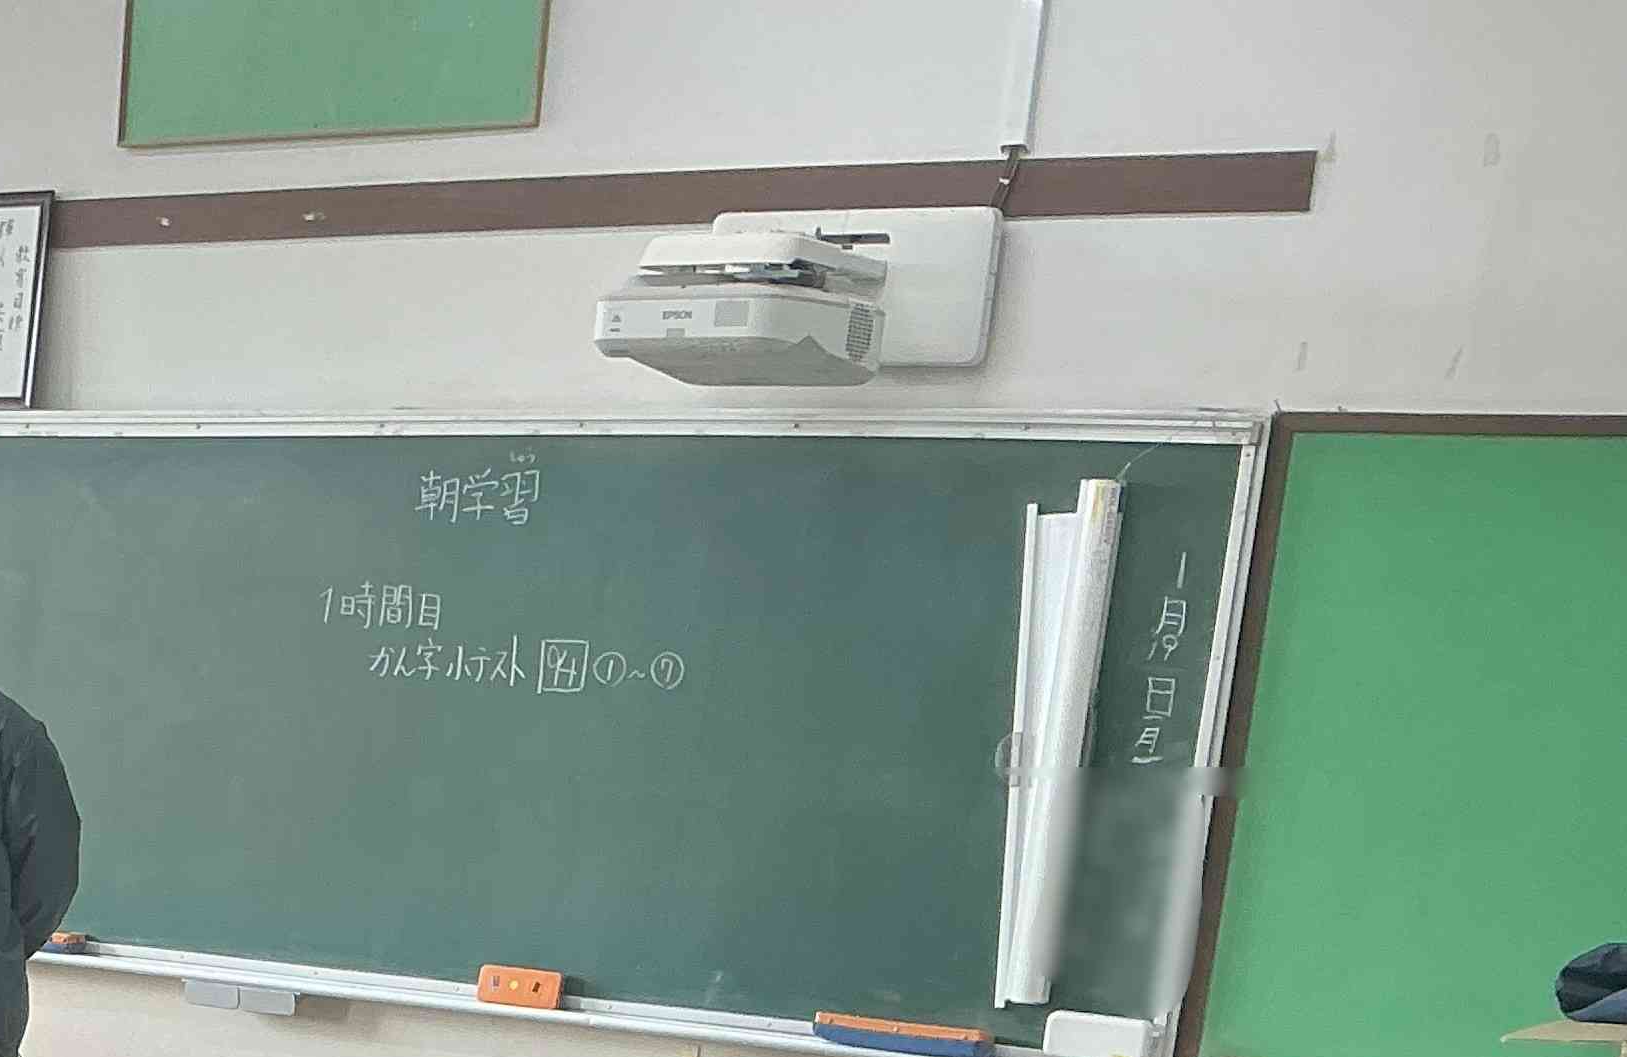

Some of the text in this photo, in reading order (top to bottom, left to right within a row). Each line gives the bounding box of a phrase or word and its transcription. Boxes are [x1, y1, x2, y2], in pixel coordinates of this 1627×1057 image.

[662, 310, 693, 320] EPSON
[414, 468, 541, 525] 朝学習
[318, 580, 443, 631] 1時間目
